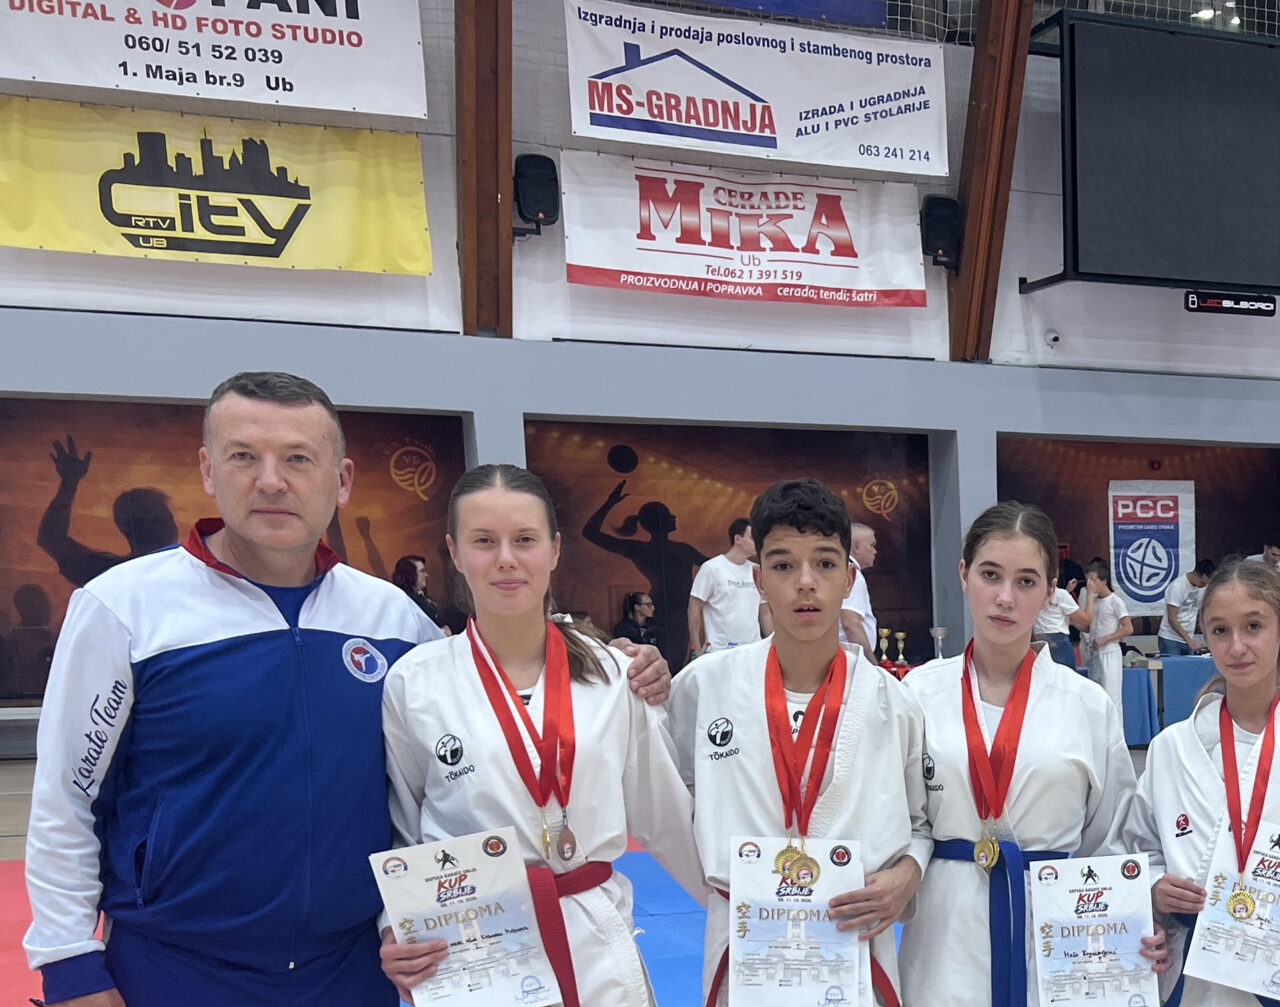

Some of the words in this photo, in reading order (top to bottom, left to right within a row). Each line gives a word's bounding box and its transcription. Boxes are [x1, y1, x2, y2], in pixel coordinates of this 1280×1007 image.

[9, 0, 115, 21] DIGITAL
[124, 7, 142, 25] &
[152, 10, 187, 31] HD
[196, 16, 262, 38] FOTO
[271, 23, 363, 48] STUDIO
[124, 33, 170, 54] 060/
[177, 40, 202, 58] 51
[211, 45, 238, 61] 52
[244, 48, 283, 64] 039
[577, 8, 646, 34] Izgradnja
[651, 21, 656, 34] i
[660, 25, 713, 45] prodaja
[716, 30, 786, 54] poslovnog
[791, 37, 795, 52] i
[799, 39, 873, 65] stambenog
[876, 52, 932, 68] prostora
[118, 61, 138, 77] 1.
[145, 63, 198, 86] Maja
[204, 70, 245, 88] br.9
[266, 76, 294, 93] Ub
[587, 79, 777, 136] MS-GRADNJA
[799, 103, 845, 122] IZRADA
[859, 85, 926, 109] UGRADNJA
[795, 123, 821, 138] ALU
[834, 115, 859, 131] PVC
[863, 99, 931, 123] STOLARIJE
[858, 143, 881, 158] 063
[884, 145, 905, 160] 241
[909, 148, 931, 163] 214
[712, 186, 806, 211] CERADE
[131, 215, 171, 229] RTV
[635, 174, 859, 259] MIKA
[139, 236, 167, 248] UB
[705, 264, 744, 280] Tel.062
[748, 268, 753, 281] 1
[756, 268, 778, 281] 391
[782, 269, 803, 282] 519
[740, 254, 761, 268] Ub
[620, 273, 699, 292] PROIZVODNJA
[707, 283, 763, 297] POPRAVKA
[852, 289, 877, 303] šatri
[73, 729, 107, 797] Karate
[91, 679, 127, 730] Team
[437, 874, 468, 892] KUP
[439, 887, 474, 902] SRBIJE
[778, 886, 812, 896] SRBIJE
[1077, 891, 1104, 904] KUP
[424, 902, 505, 931] DIPLOMA
[759, 907, 831, 921] DIPLOMA
[1060, 922, 1128, 939] DIPLOMA
